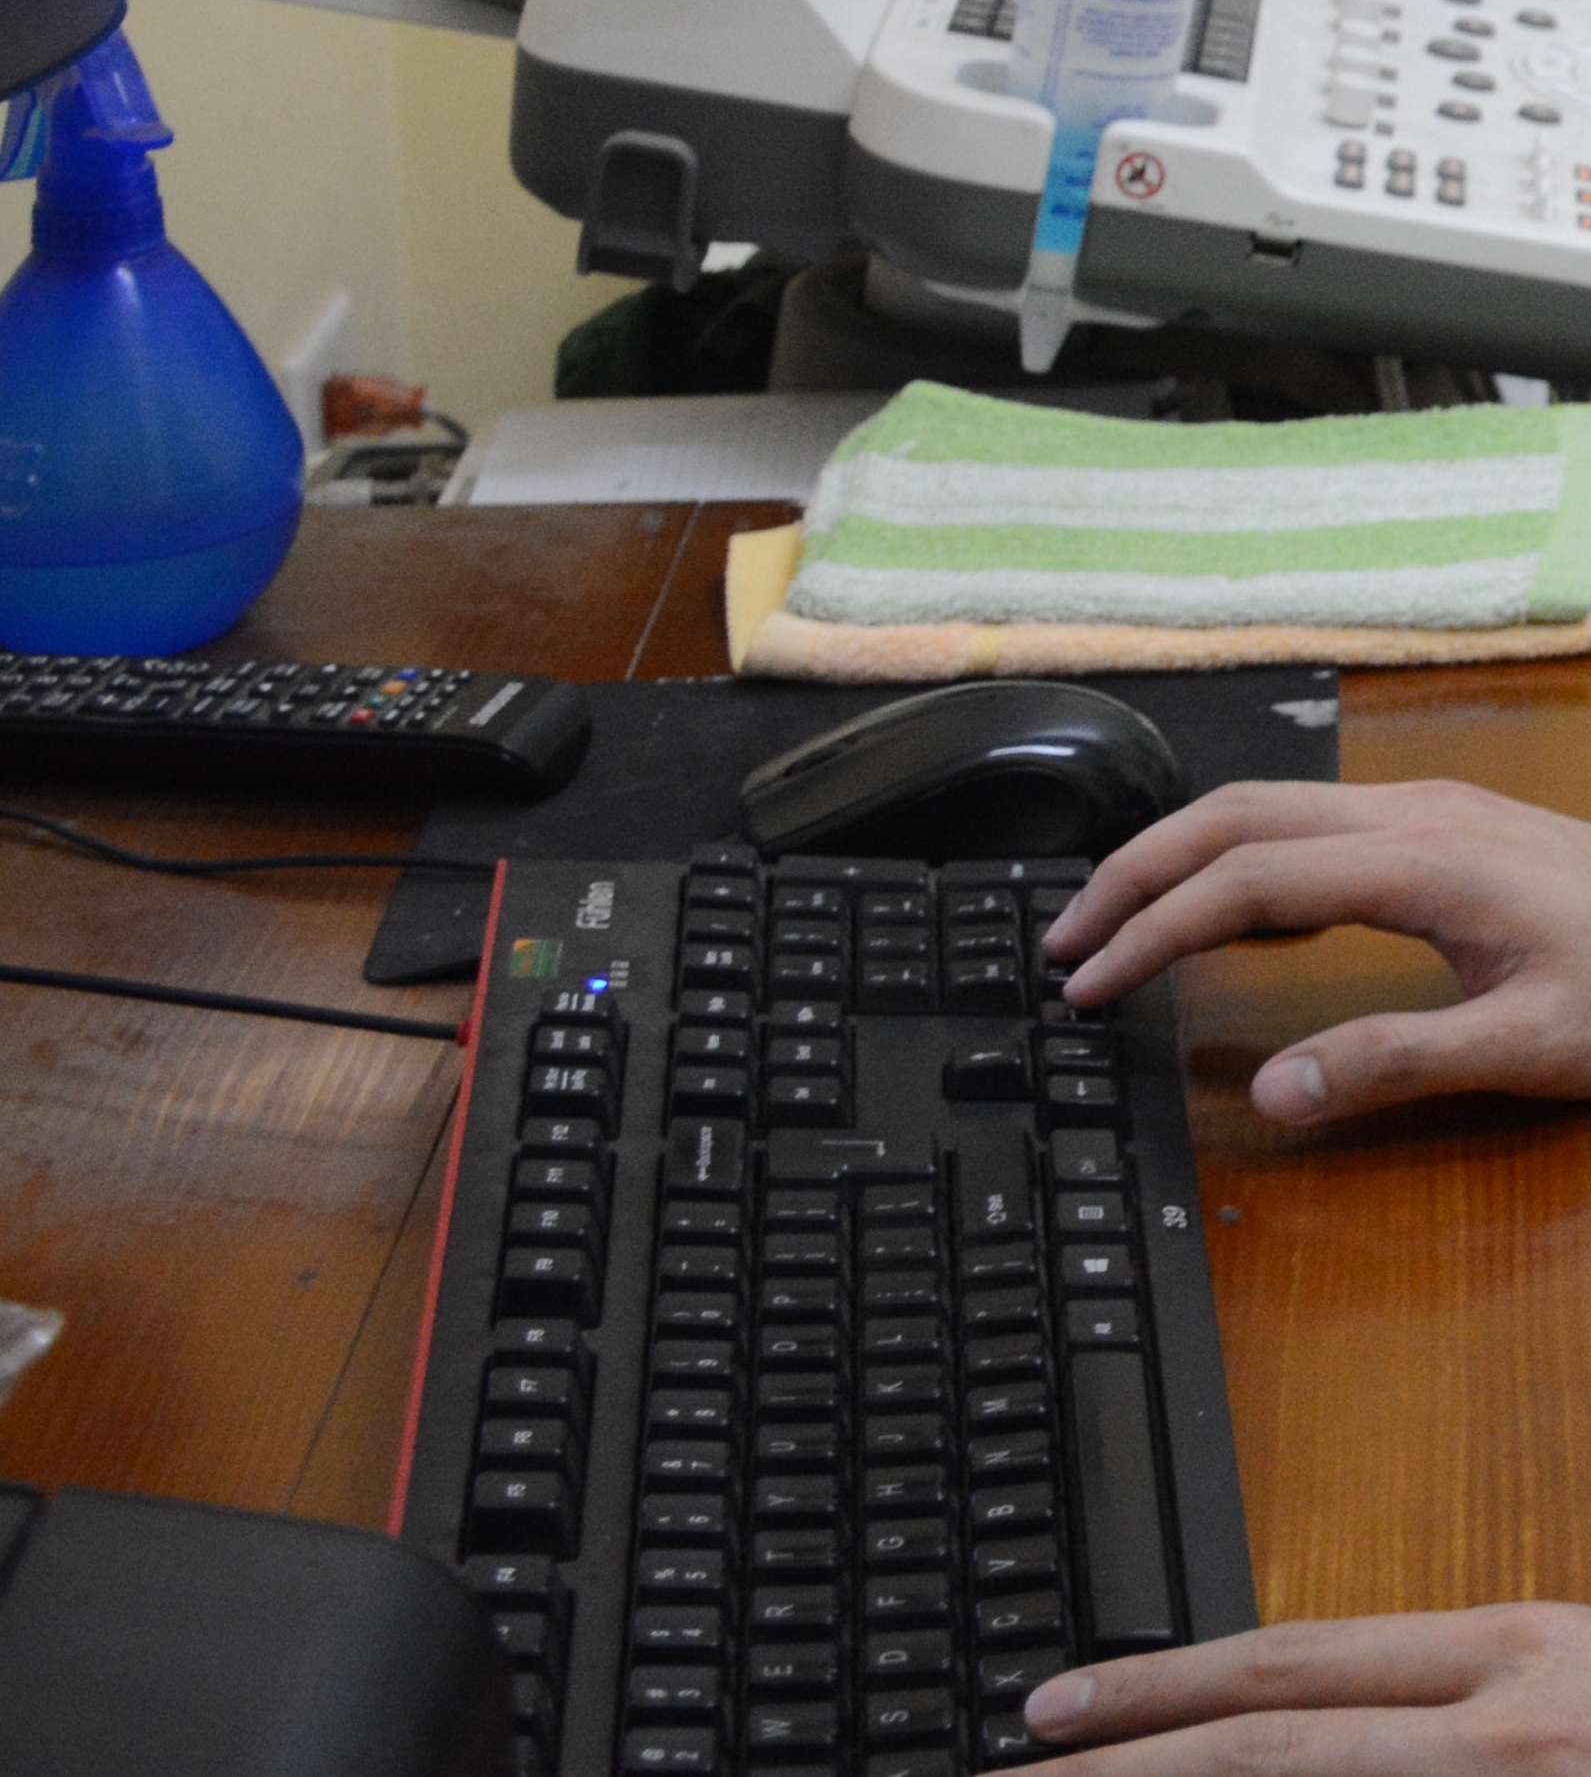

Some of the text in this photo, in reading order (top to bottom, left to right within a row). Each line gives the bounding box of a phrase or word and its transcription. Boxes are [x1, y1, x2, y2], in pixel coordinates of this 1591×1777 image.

[1161, 1204, 1188, 1229] 39
[772, 1294, 798, 1305] P
[877, 1333, 903, 1345] L
[771, 1341, 798, 1352] O
[518, 1378, 537, 1393] F7
[877, 1381, 902, 1394] K
[982, 1397, 1007, 1414] M
[769, 1441, 796, 1453] U
[984, 1449, 1011, 1465] N
[877, 1483, 905, 1497] H
[767, 1494, 795, 1507] Y
[986, 1503, 1015, 1518] B
[876, 1535, 905, 1550] G
[764, 1550, 792, 1562] T
[988, 1559, 1016, 1572] V
[876, 1596, 905, 1607] F
[764, 1604, 793, 1618] R
[990, 1613, 1020, 1629] C
[877, 1649, 908, 1665] D
[762, 1664, 793, 1677] E
[994, 1670, 1023, 1687] X
[879, 1710, 909, 1724] S
[762, 1719, 790, 1737] W
[996, 1733, 1029, 1750] Z
[674, 1750, 699, 1761] 2
